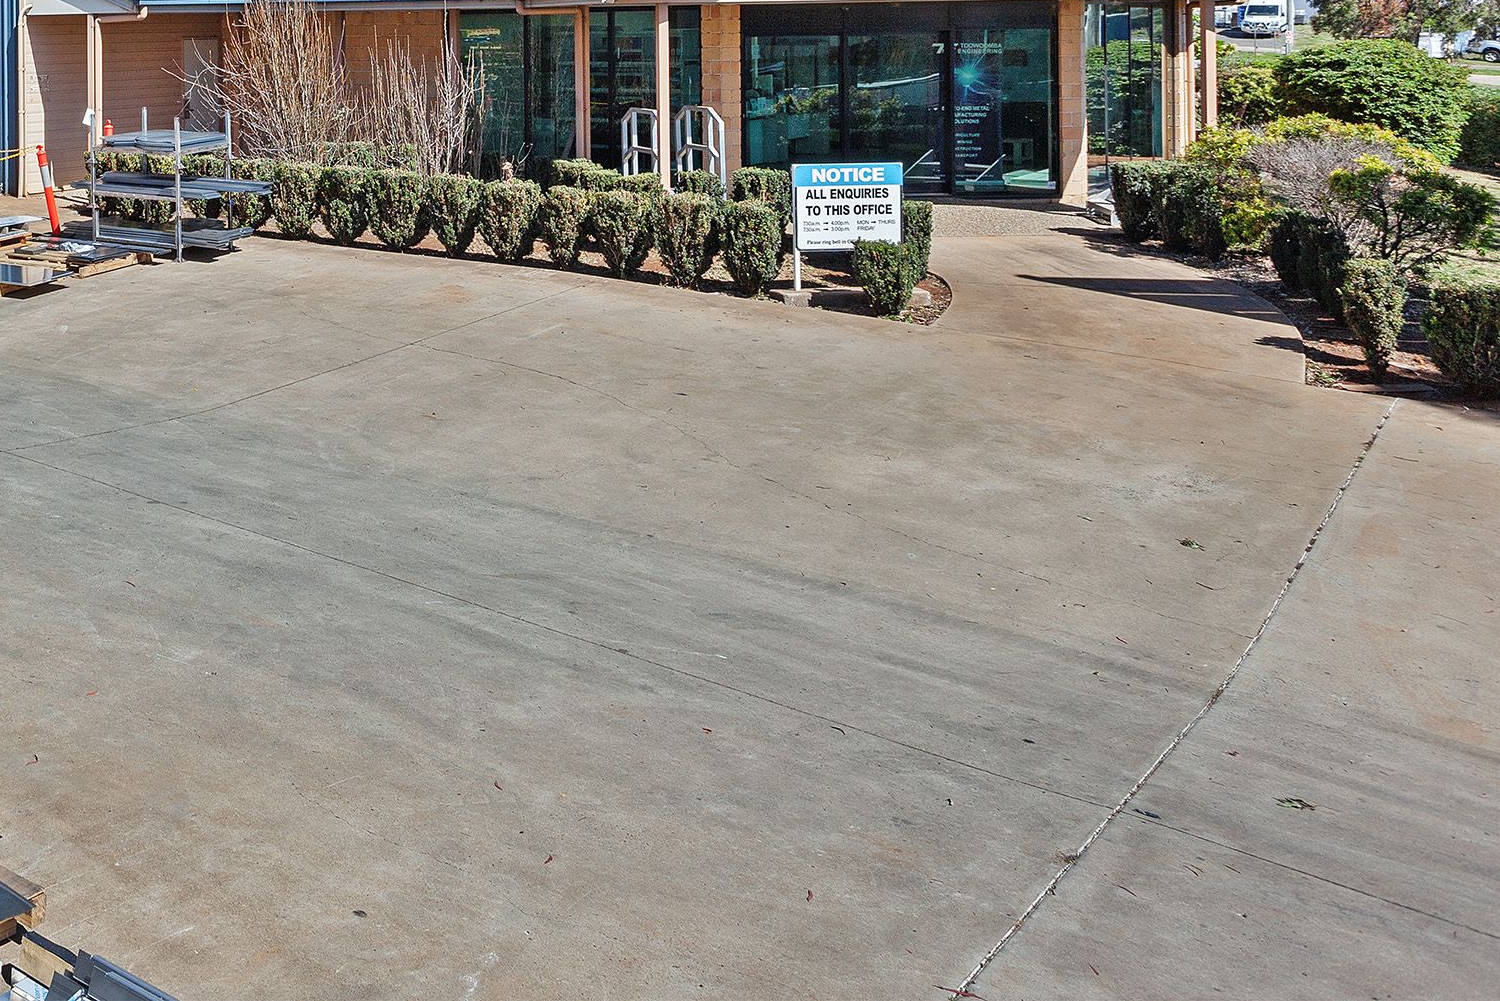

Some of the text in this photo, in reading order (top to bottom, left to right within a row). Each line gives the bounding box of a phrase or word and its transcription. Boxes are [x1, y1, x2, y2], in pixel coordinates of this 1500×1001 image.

[811, 167, 885, 183] NOTICE
[805, 187, 889, 200] ALL ENQUIRIES
[805, 204, 893, 216] TO THIS OFFICE
